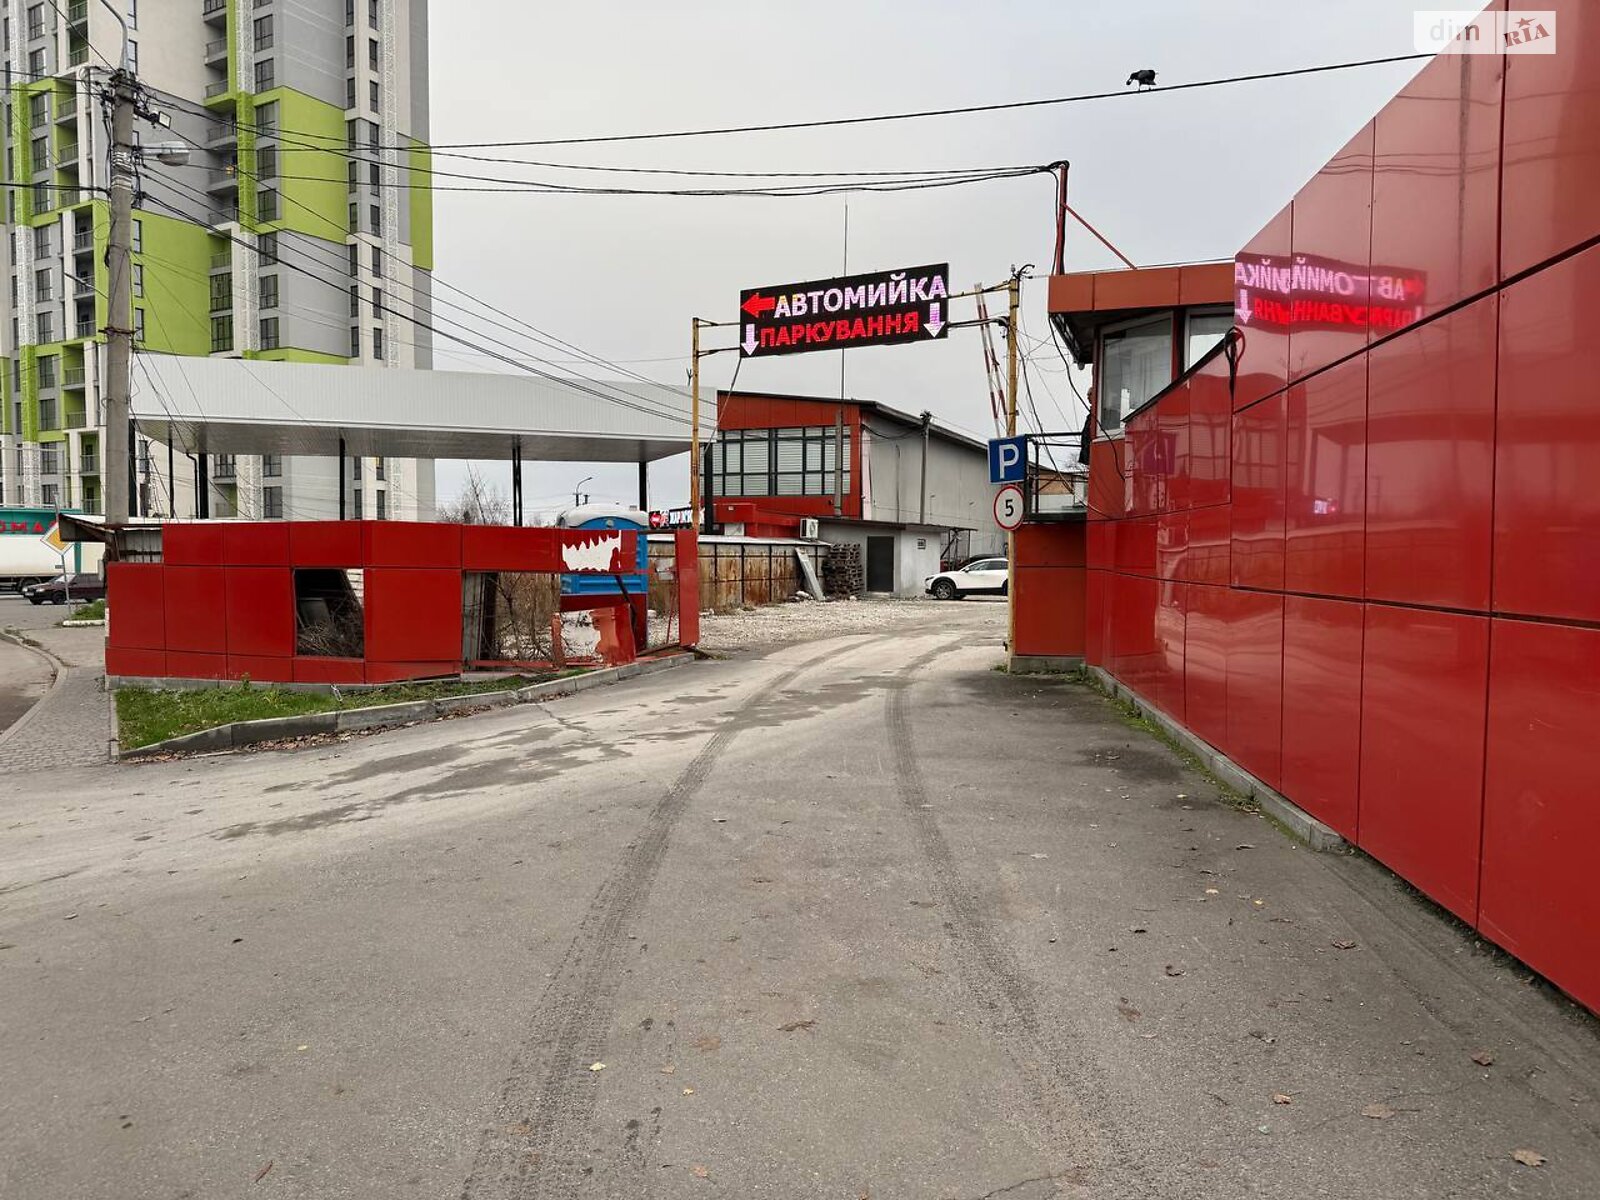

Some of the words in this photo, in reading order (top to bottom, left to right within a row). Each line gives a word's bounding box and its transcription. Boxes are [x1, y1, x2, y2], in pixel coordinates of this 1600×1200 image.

[773, 271, 947, 319] АВТОМИЙКА
[760, 311, 919, 348] ПАРКУВАННЯ
[998, 443, 1020, 480] P
[1004, 498, 1015, 518] 5
